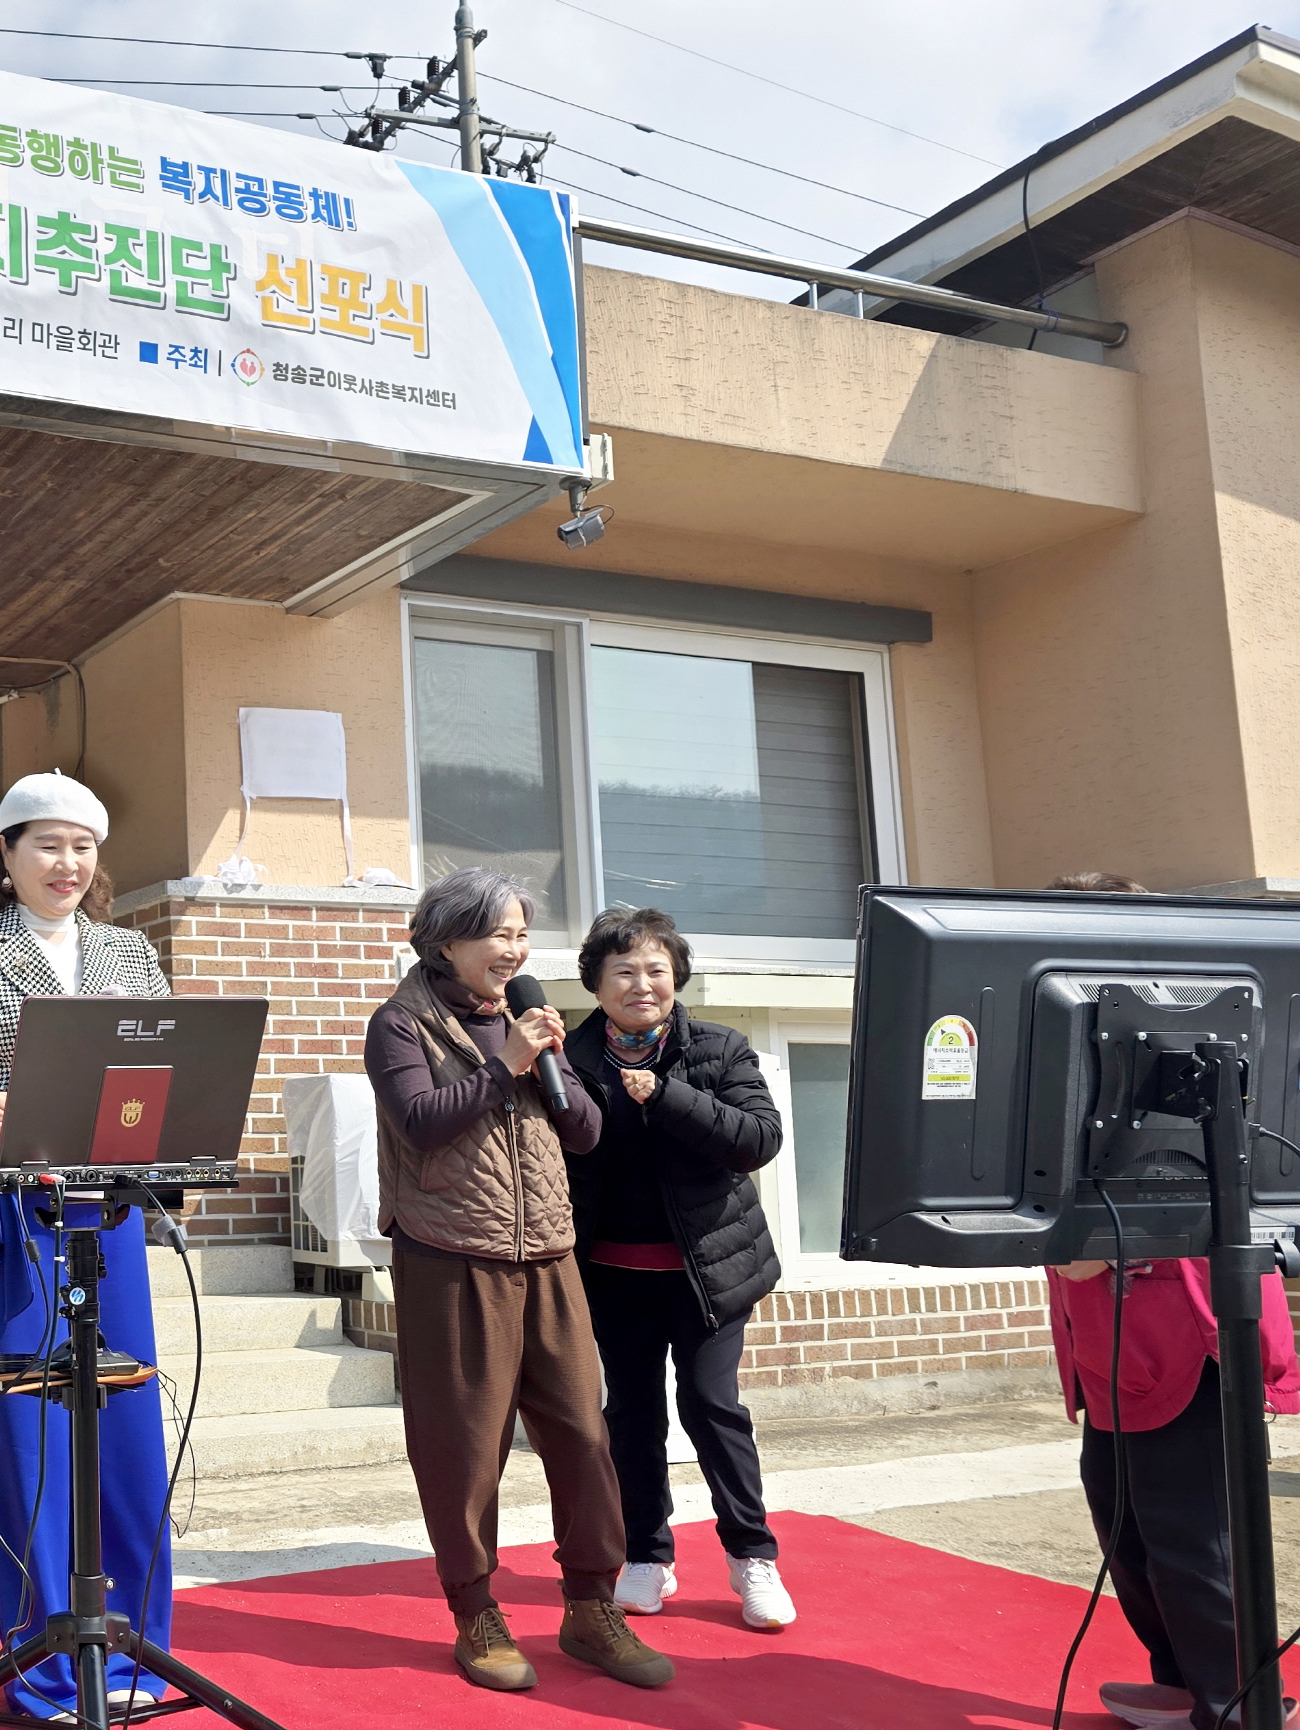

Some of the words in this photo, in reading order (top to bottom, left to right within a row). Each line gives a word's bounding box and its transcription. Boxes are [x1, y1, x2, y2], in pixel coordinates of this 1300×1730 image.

[159, 154, 358, 232] 복지공동체!
[253, 250, 431, 360] 선포식
[30, 325, 120, 361] 마을회관
[165, 343, 209, 375] 주최
[271, 360, 458, 412] 청송군이웃사촌복지센터
[117, 1020, 176, 1036] ELF
[948, 1036, 954, 1045] 2
